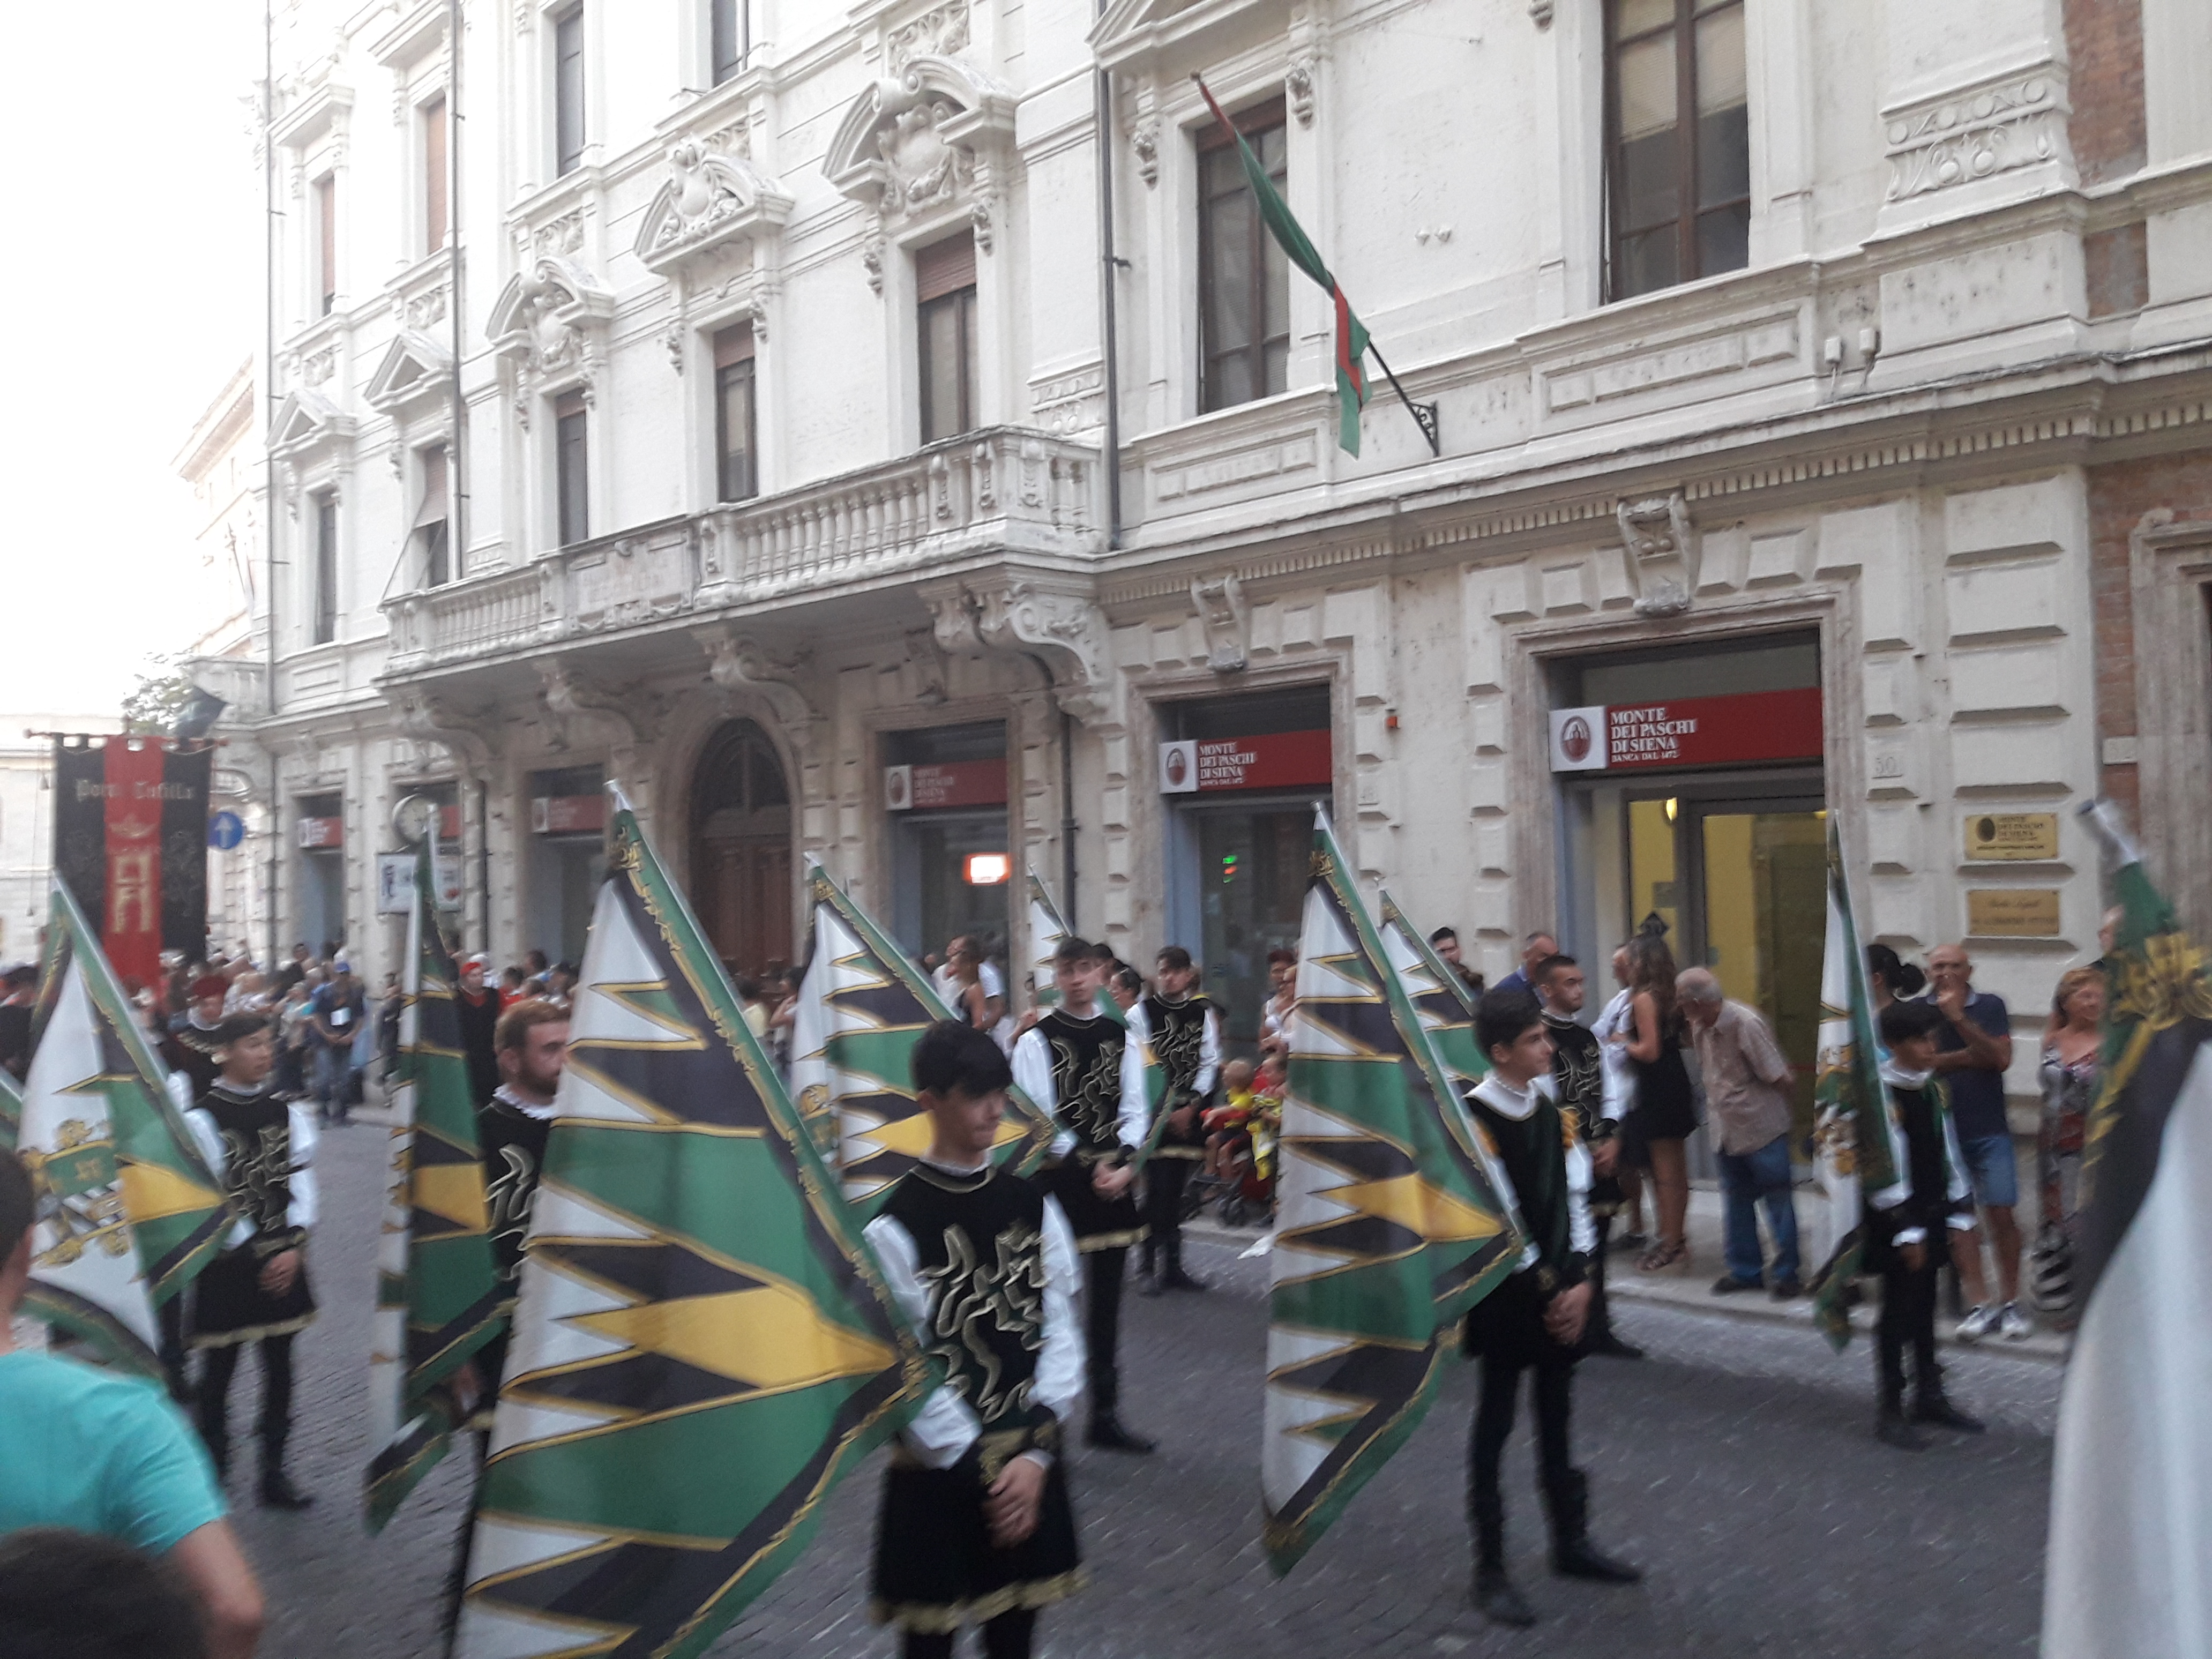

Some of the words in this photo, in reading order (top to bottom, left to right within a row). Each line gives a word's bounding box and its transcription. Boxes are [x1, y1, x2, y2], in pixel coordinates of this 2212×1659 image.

[1611, 707, 1667, 724] MONTE
[1611, 724, 1636, 739] DEI
[1640, 720, 1697, 737] PASCHI
[1199, 743, 1236, 756] MONTE
[1612, 739, 1627, 753] DI
[1630, 736, 1677, 752] SIENA
[1200, 756, 1216, 767] DEI
[1218, 752, 1256, 766] PASCHI
[1612, 753, 1639, 762] BANCA
[1642, 751, 1658, 760] DAL
[1200, 768, 1211, 779] DI
[1212, 766, 1243, 778] SIENA
